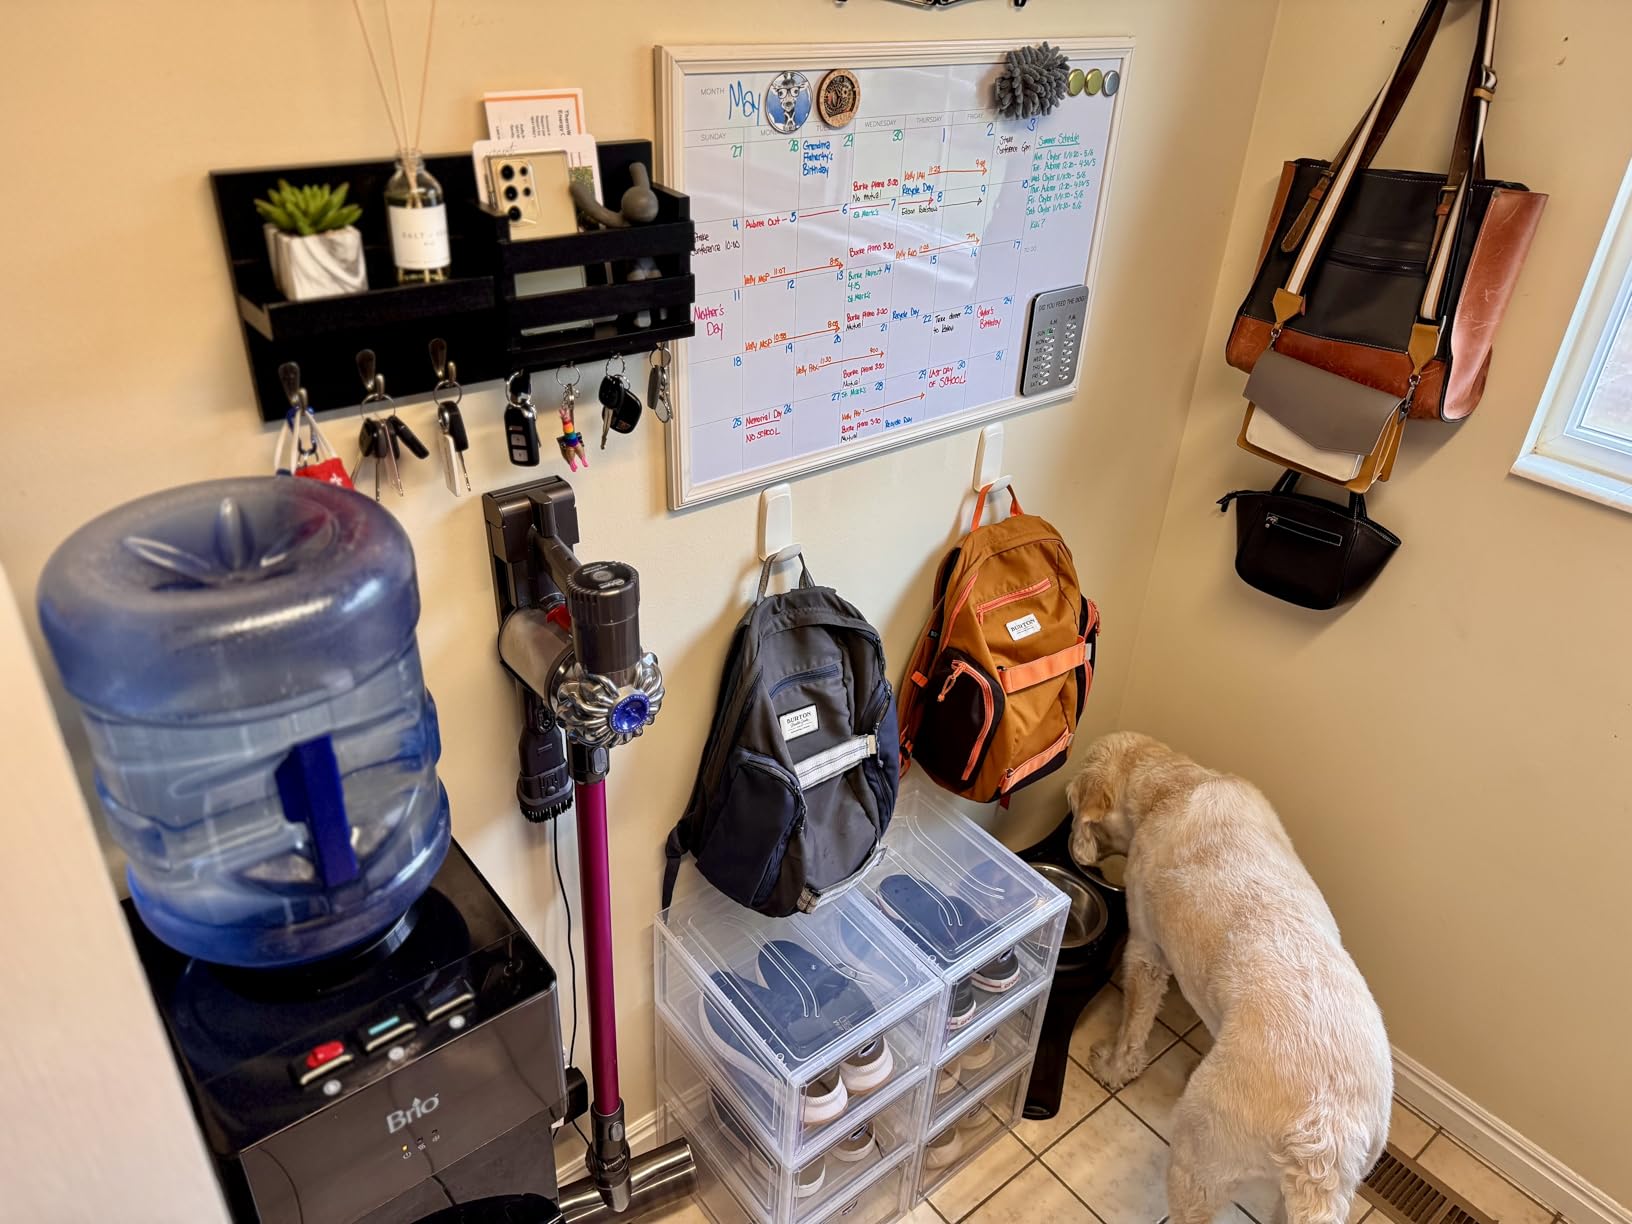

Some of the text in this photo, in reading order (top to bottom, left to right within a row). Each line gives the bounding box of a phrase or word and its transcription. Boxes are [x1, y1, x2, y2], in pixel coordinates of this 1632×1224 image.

[701, 87, 725, 96] MONTH
[728, 79, 761, 127] May
[864, 119, 897, 128] WEDNESDAY
[916, 115, 943, 124] THURSDAY
[892, 129, 903, 142] 30
[986, 123, 994, 136] 2
[700, 133, 726, 142] SUNDAY
[843, 133, 854, 148] 29
[731, 144, 743, 159] 27
[788, 138, 800, 153] 28
[922, 182, 935, 197] Day
[980, 184, 986, 196] 9
[936, 191, 943, 203] 8
[841, 203, 848, 215] 6
[890, 198, 897, 212] 7
[767, 216, 781, 227] Out
[789, 211, 798, 224] 5
[732, 218, 740, 231] 4
[1012, 240, 1021, 250] 17
[929, 255, 938, 265] 15
[836, 269, 844, 281] 13
[786, 279, 795, 290] 12
[733, 289, 741, 302] 11
[1003, 295, 1013, 305] 24
[910, 307, 920, 319] Day
[963, 304, 974, 315] 23
[922, 314, 932, 324] 22
[706, 321, 725, 340] Day
[880, 322, 888, 332] 21
[785, 342, 793, 355] 19
[732, 356, 743, 367] 18
[957, 359, 967, 370] 30
[918, 369, 927, 381] 29
[874, 381, 884, 391] 28
[831, 392, 841, 402] 27
[772, 408, 783, 421] Day
[783, 403, 793, 415] 26
[732, 417, 743, 429] 25
[745, 434, 756, 444] NO
[1010, 618, 1036, 632] BURTON
[786, 711, 812, 724] BURTON
